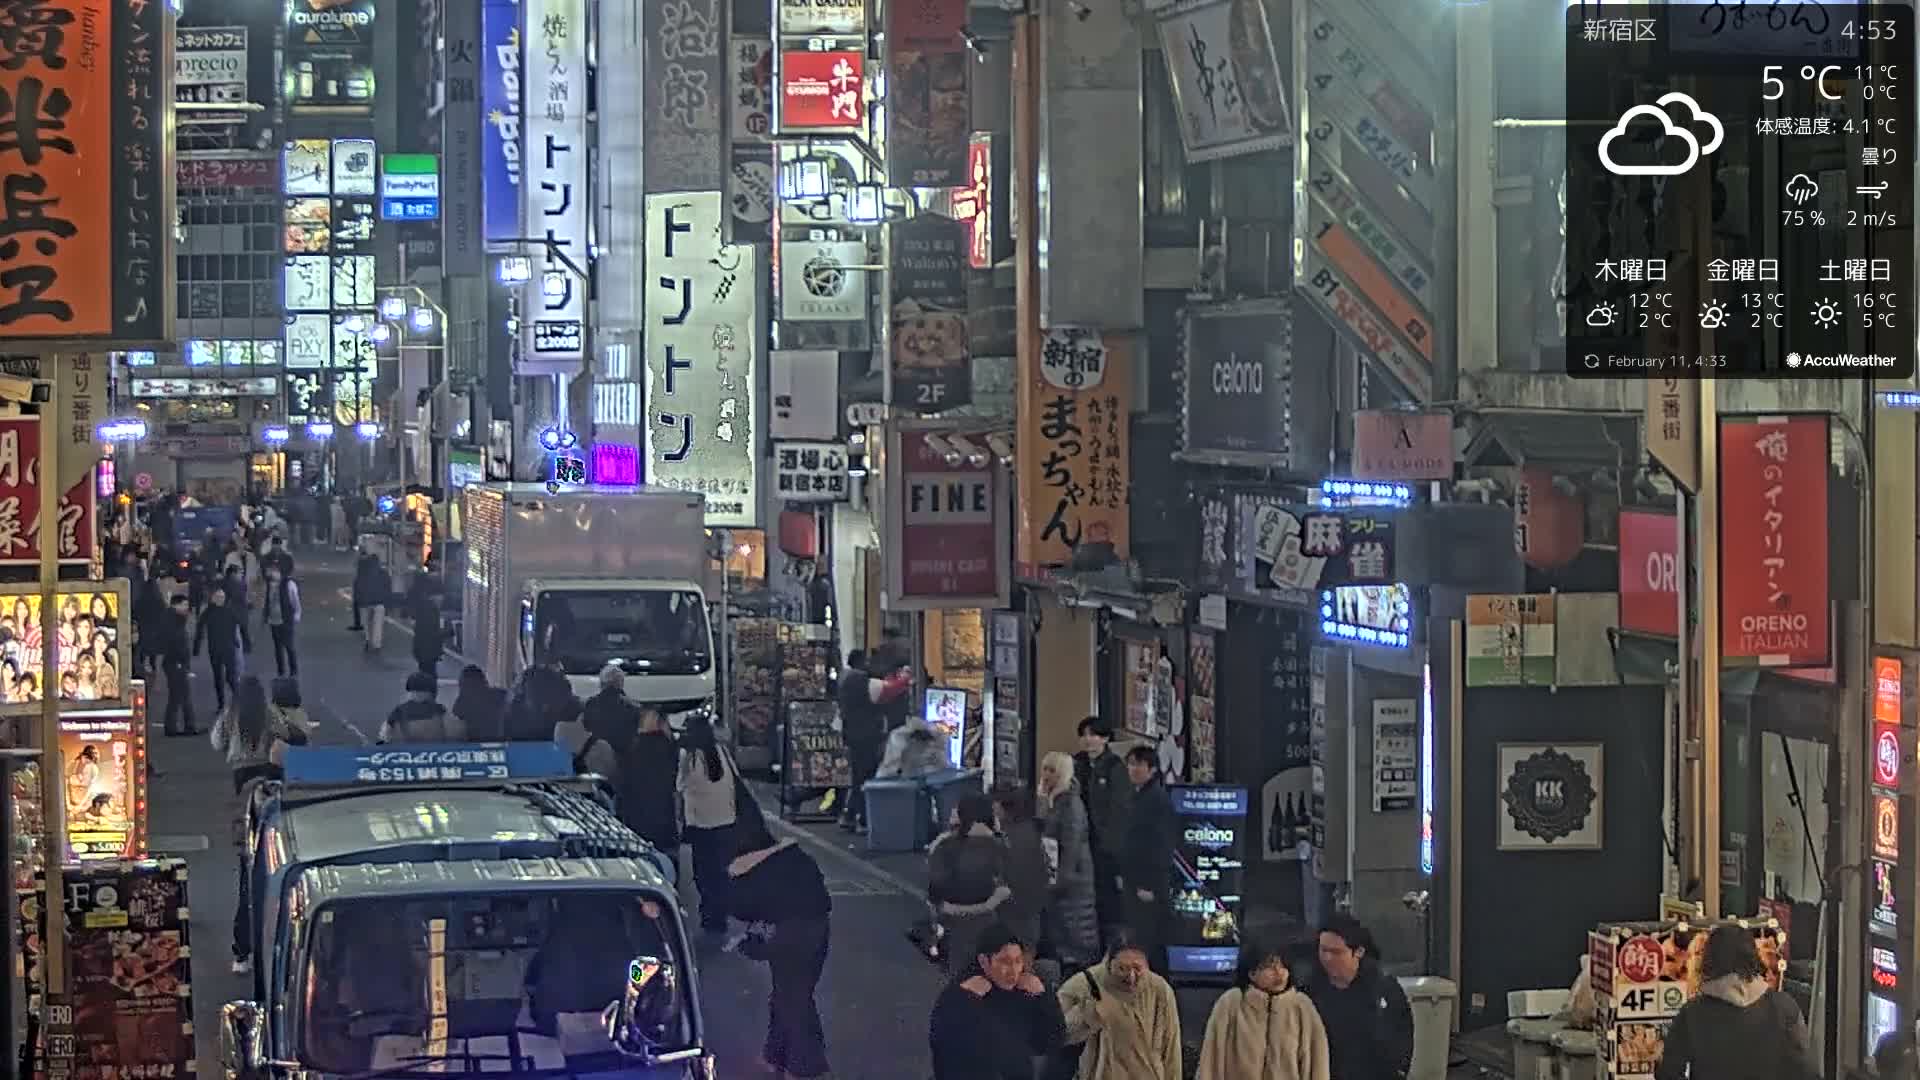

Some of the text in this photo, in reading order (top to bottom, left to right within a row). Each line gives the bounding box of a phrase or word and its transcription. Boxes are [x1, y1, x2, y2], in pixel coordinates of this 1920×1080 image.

[386, 179, 437, 192] FamilyMart
[1213, 353, 1262, 394] celona
[72, 352, 92, 444] 通り一番街
[917, 384, 946, 403] 2F
[1040, 396, 1086, 548] まっちゃん
[911, 483, 987, 514] FINE
[1756, 430, 1789, 603] 俺のイタリアン
[1349, 519, 1390, 535] フリー
[1647, 551, 1681, 593] OR
[1741, 614, 1808, 632] ORENO
[1740, 633, 1809, 651] ITALIAN
[1535, 781, 1564, 798] KK
[1184, 828, 1234, 842] celona
[1620, 989, 1655, 1011] 4F
